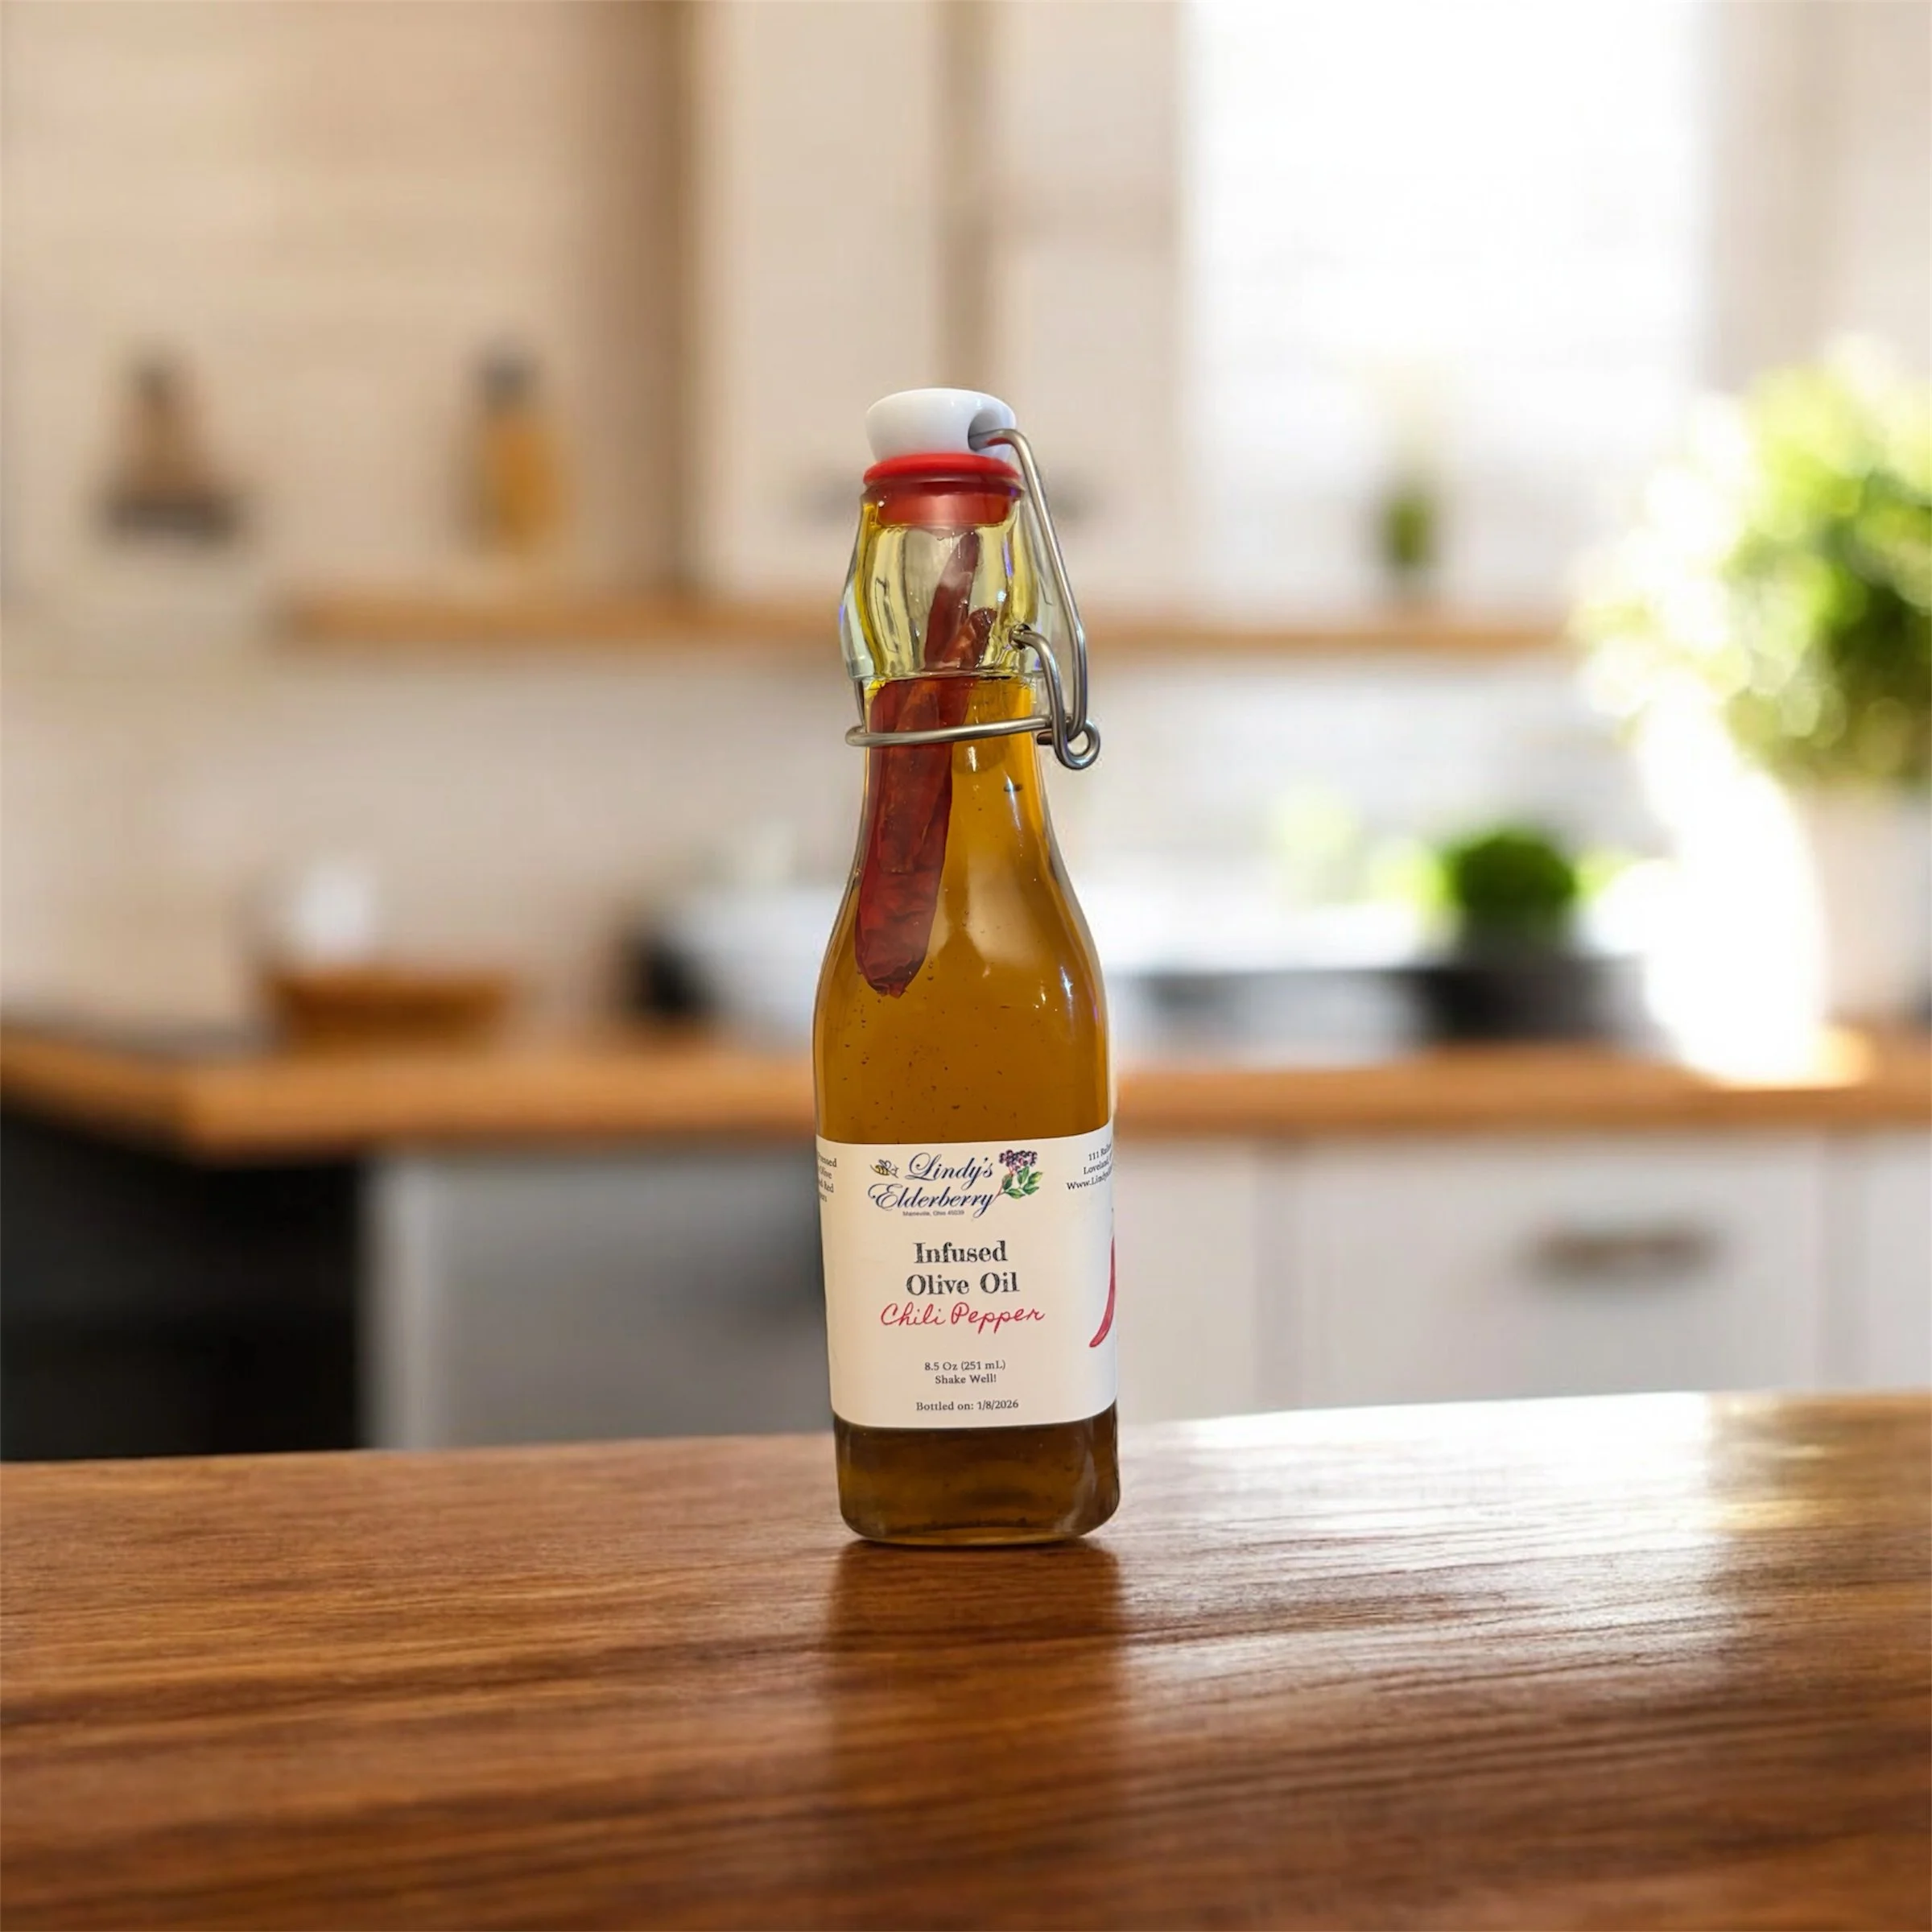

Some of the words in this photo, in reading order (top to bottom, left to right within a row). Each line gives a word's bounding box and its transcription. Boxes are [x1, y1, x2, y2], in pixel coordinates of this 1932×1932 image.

[1088, 1150, 1100, 1161] 111
[905, 1152, 993, 1191] Lindy's
[868, 1183, 993, 1219] Elderberry
[913, 1240, 1008, 1264] Infused
[906, 1274, 970, 1295] Olive
[980, 1272, 1020, 1294] Oil
[881, 1302, 946, 1326] Chili
[950, 1302, 1046, 1335] Pepper
[924, 1362, 940, 1371] 8.5
[943, 1362, 958, 1371] Oz
[960, 1360, 981, 1372] (251
[985, 1360, 1006, 1370] mL)
[935, 1375, 967, 1385] Shake
[969, 1373, 997, 1384] Well!
[916, 1402, 955, 1411] Bottled
[957, 1402, 974, 1410] on:
[976, 1399, 1019, 1410] 1/8/2026
